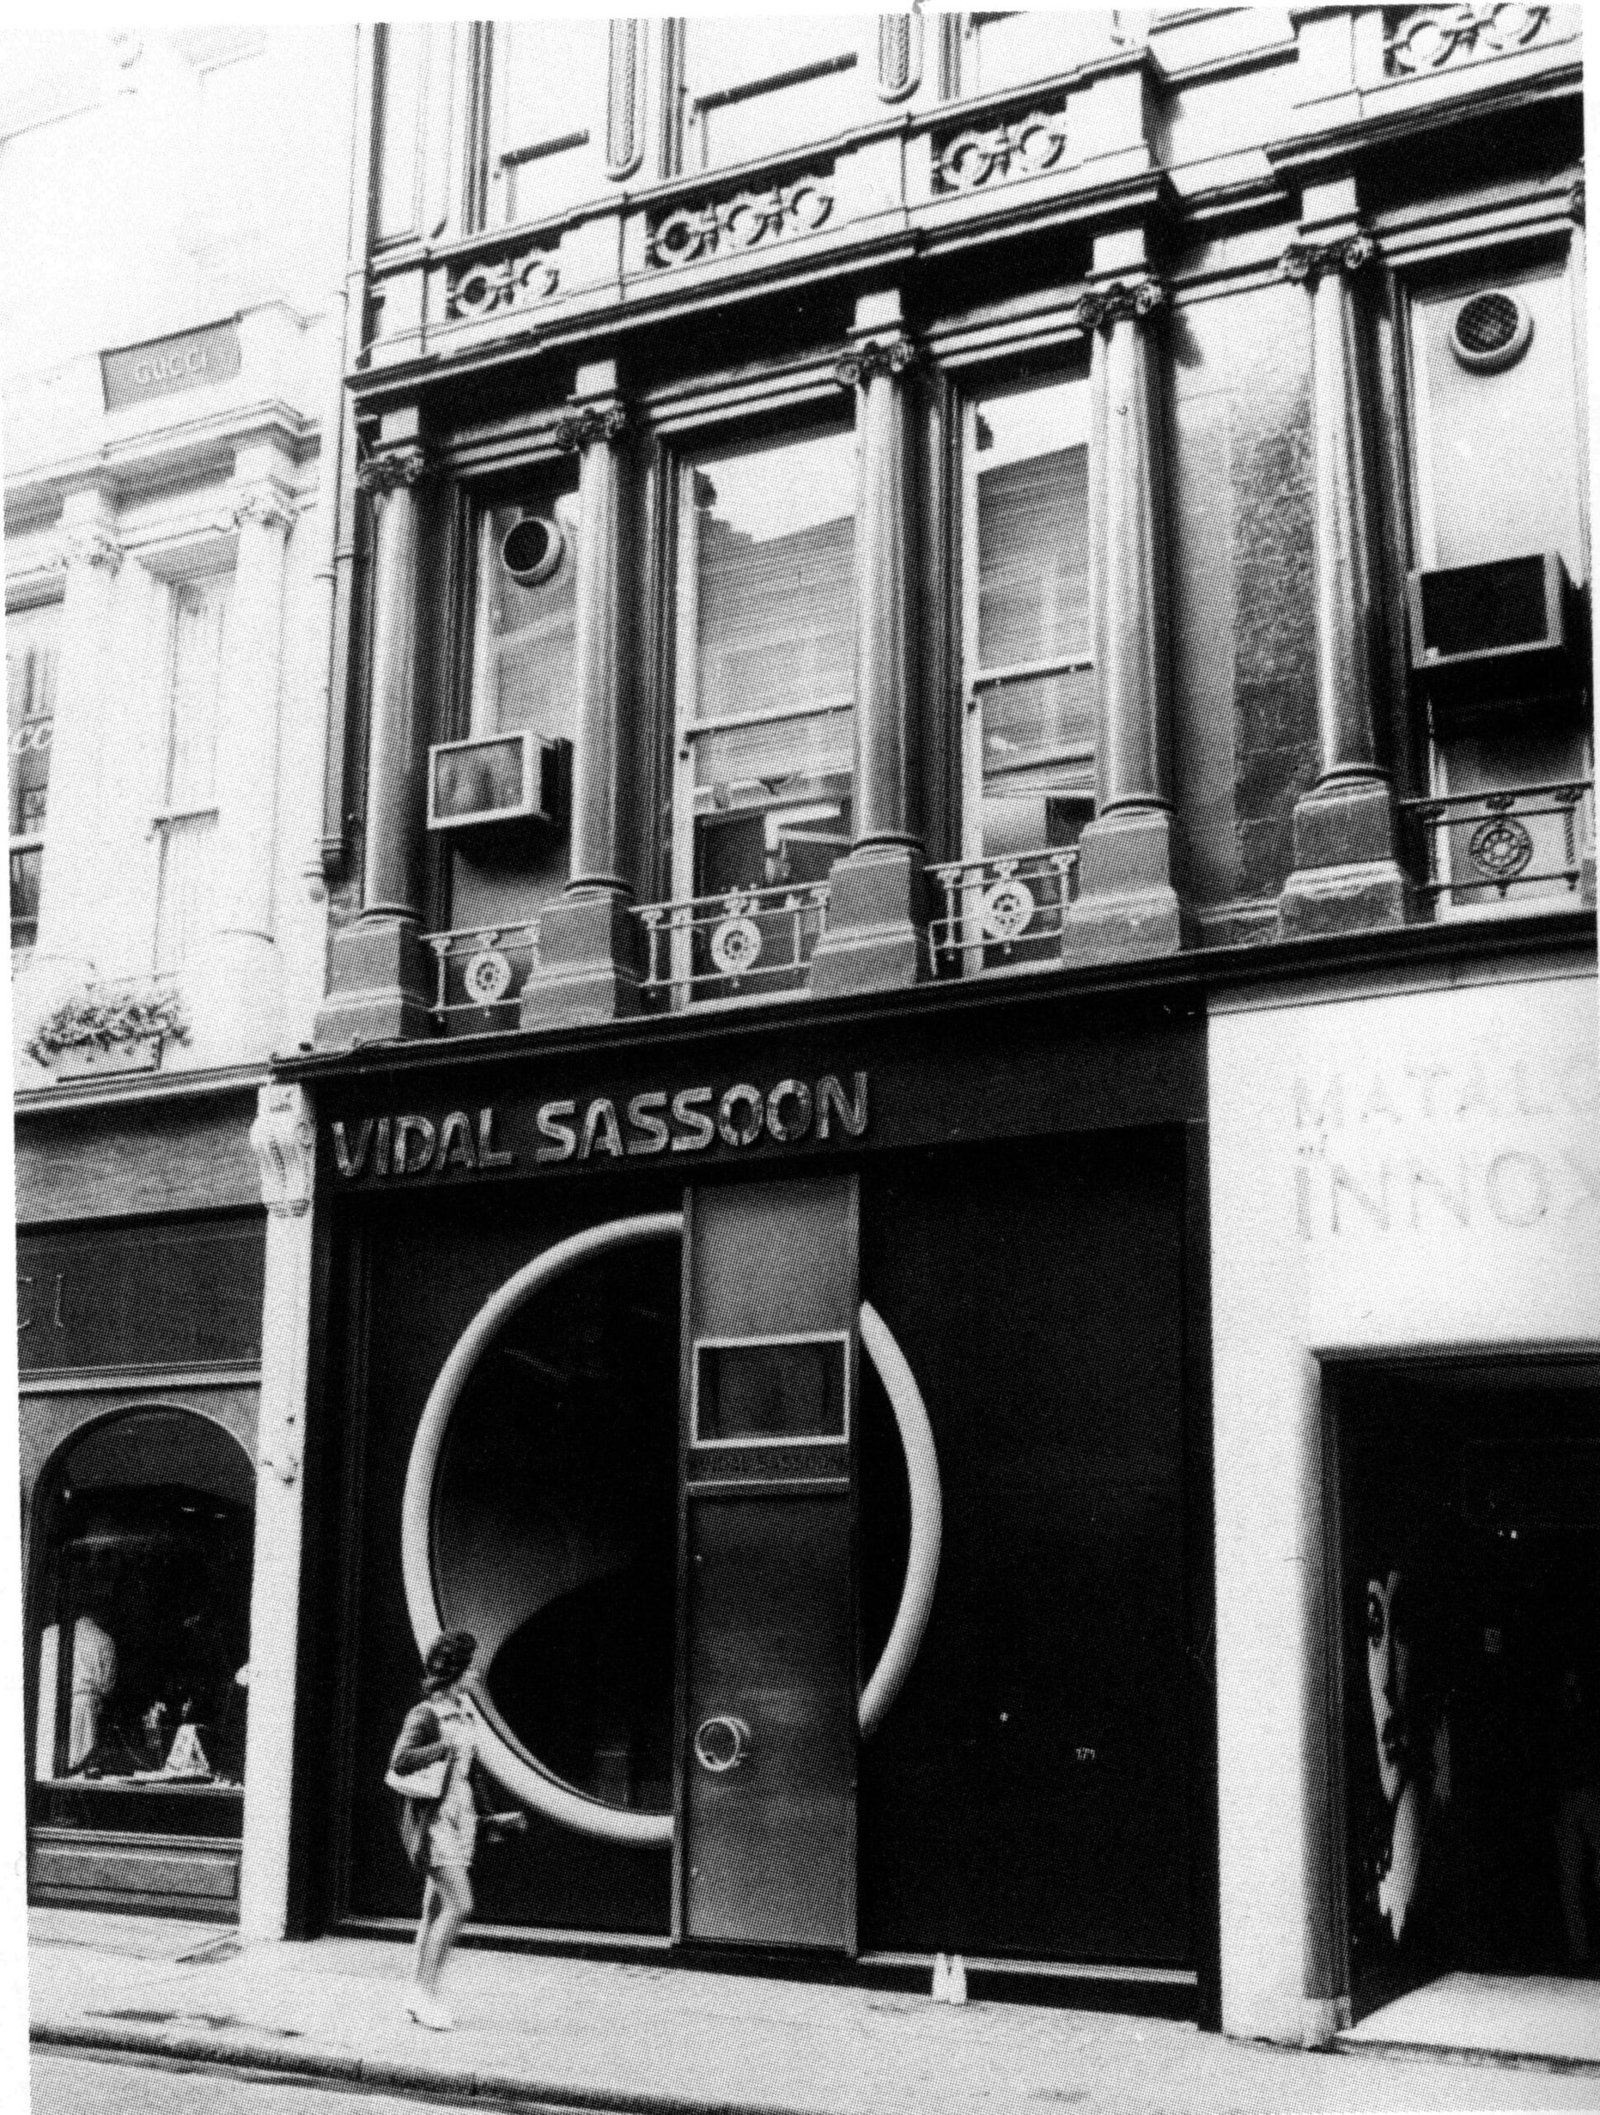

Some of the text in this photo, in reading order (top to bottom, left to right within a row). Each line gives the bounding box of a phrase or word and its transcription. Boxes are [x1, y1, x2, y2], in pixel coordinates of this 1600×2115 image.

[133, 346, 208, 385] GUCCI
[332, 1070, 868, 1177] VIDAL SASSOON
